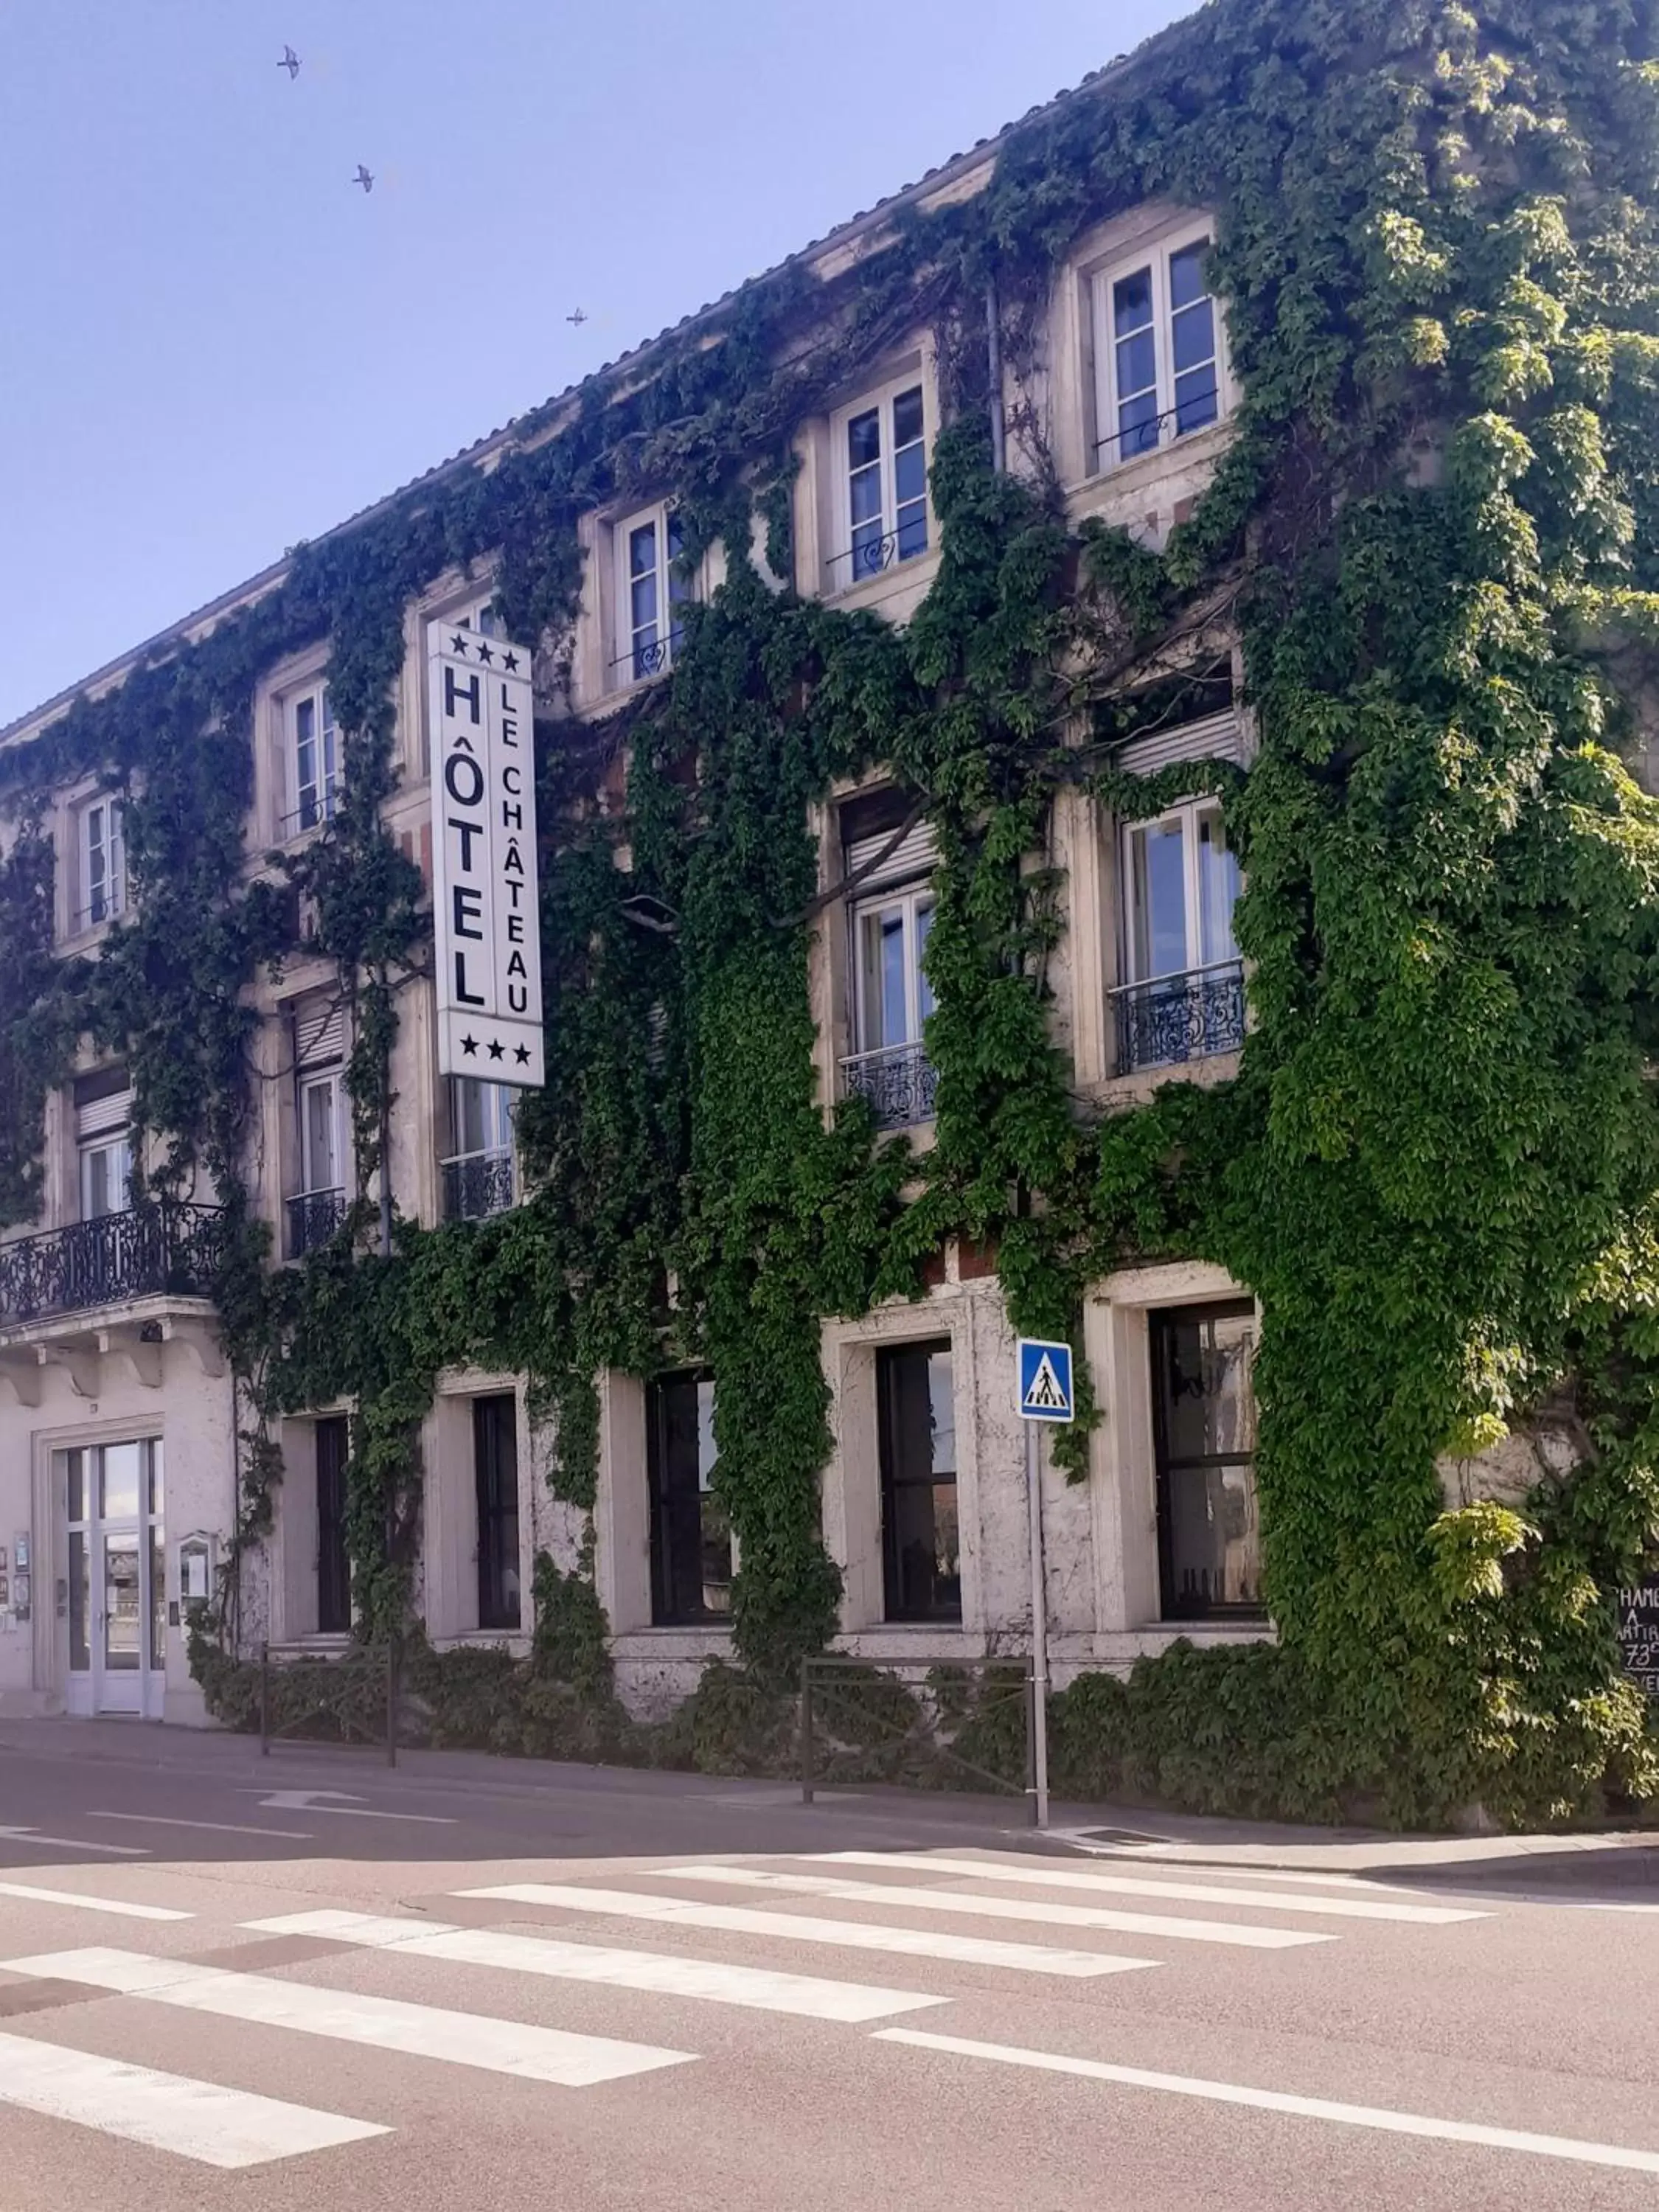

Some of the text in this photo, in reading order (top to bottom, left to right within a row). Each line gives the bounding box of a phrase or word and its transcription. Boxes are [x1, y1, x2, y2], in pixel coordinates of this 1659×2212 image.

[445, 666, 485, 1006] HÔTEL
[501, 683, 527, 1012] LE CHÂTEAU
